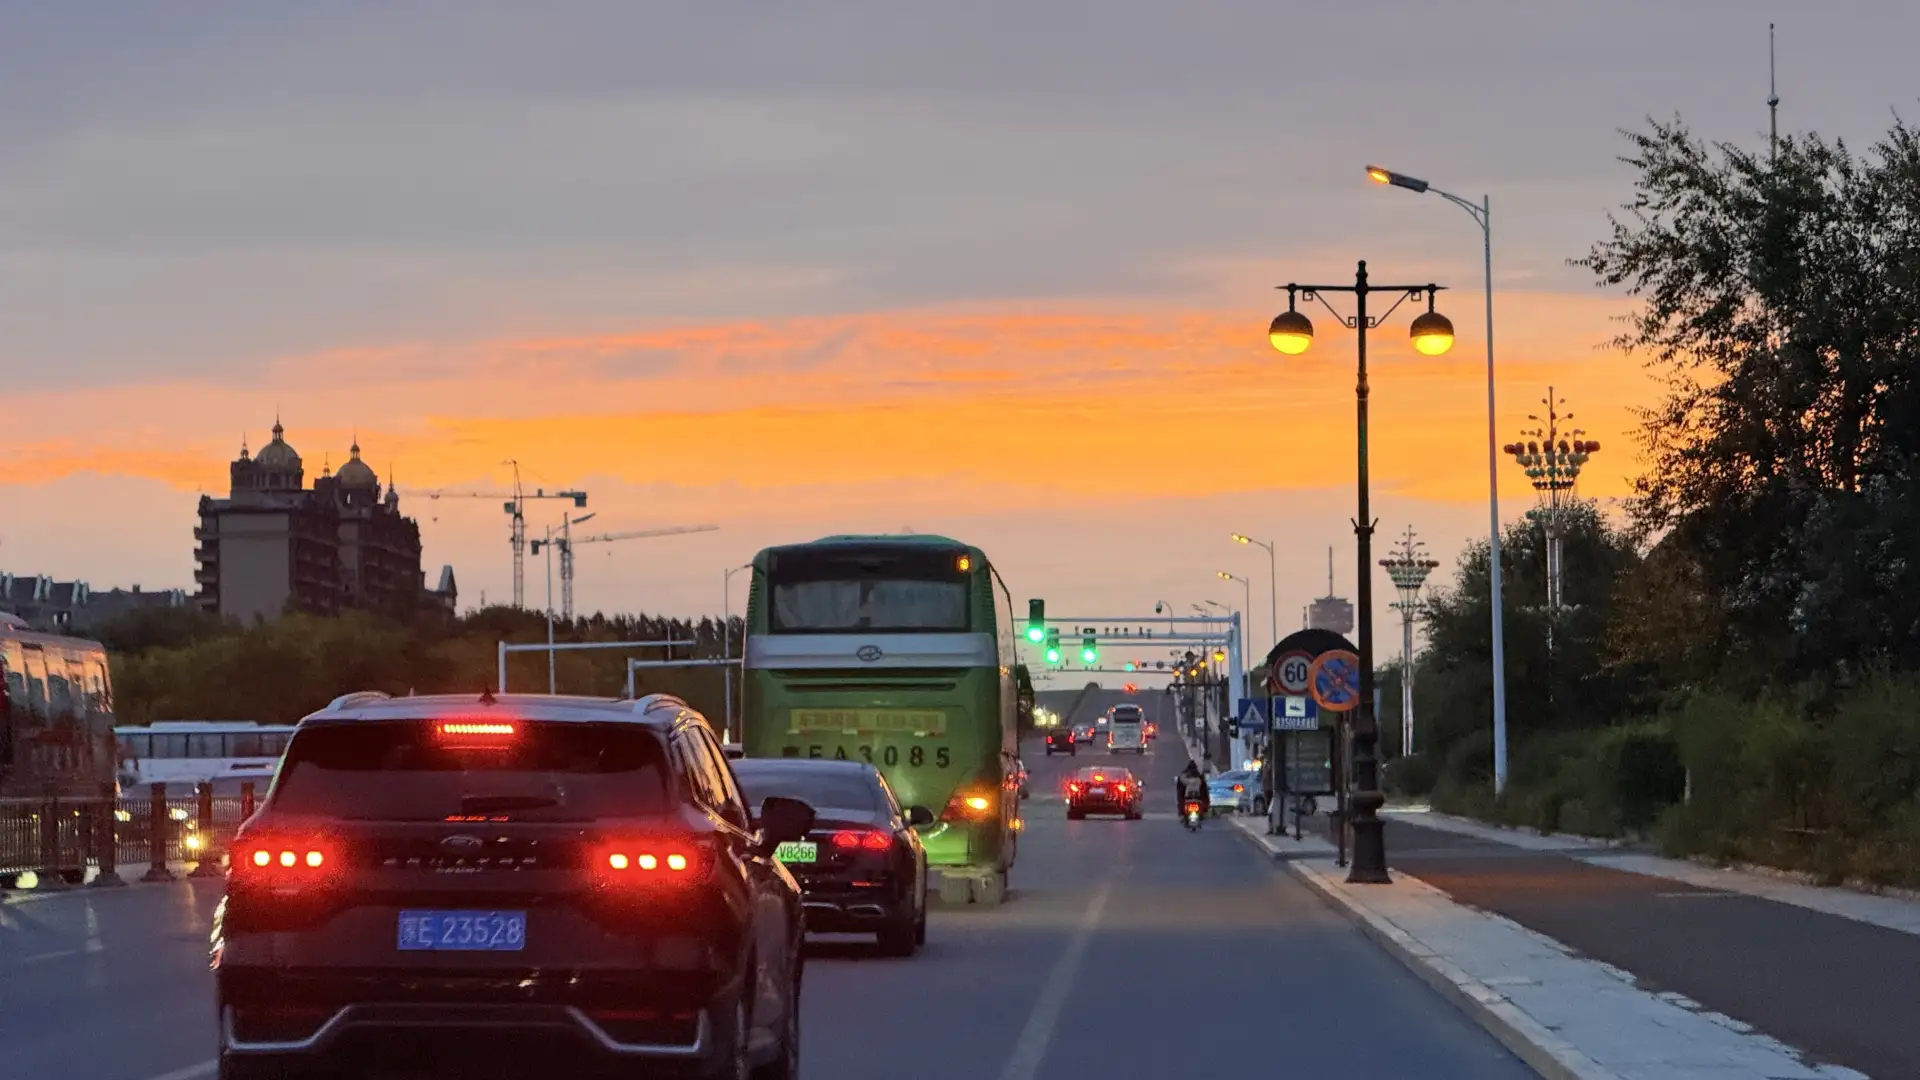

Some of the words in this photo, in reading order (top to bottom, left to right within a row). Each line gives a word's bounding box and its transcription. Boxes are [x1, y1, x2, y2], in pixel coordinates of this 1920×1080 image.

[1285, 662, 1307, 683] 60
[778, 845, 815, 859] V8266
[441, 916, 521, 945] 23528
